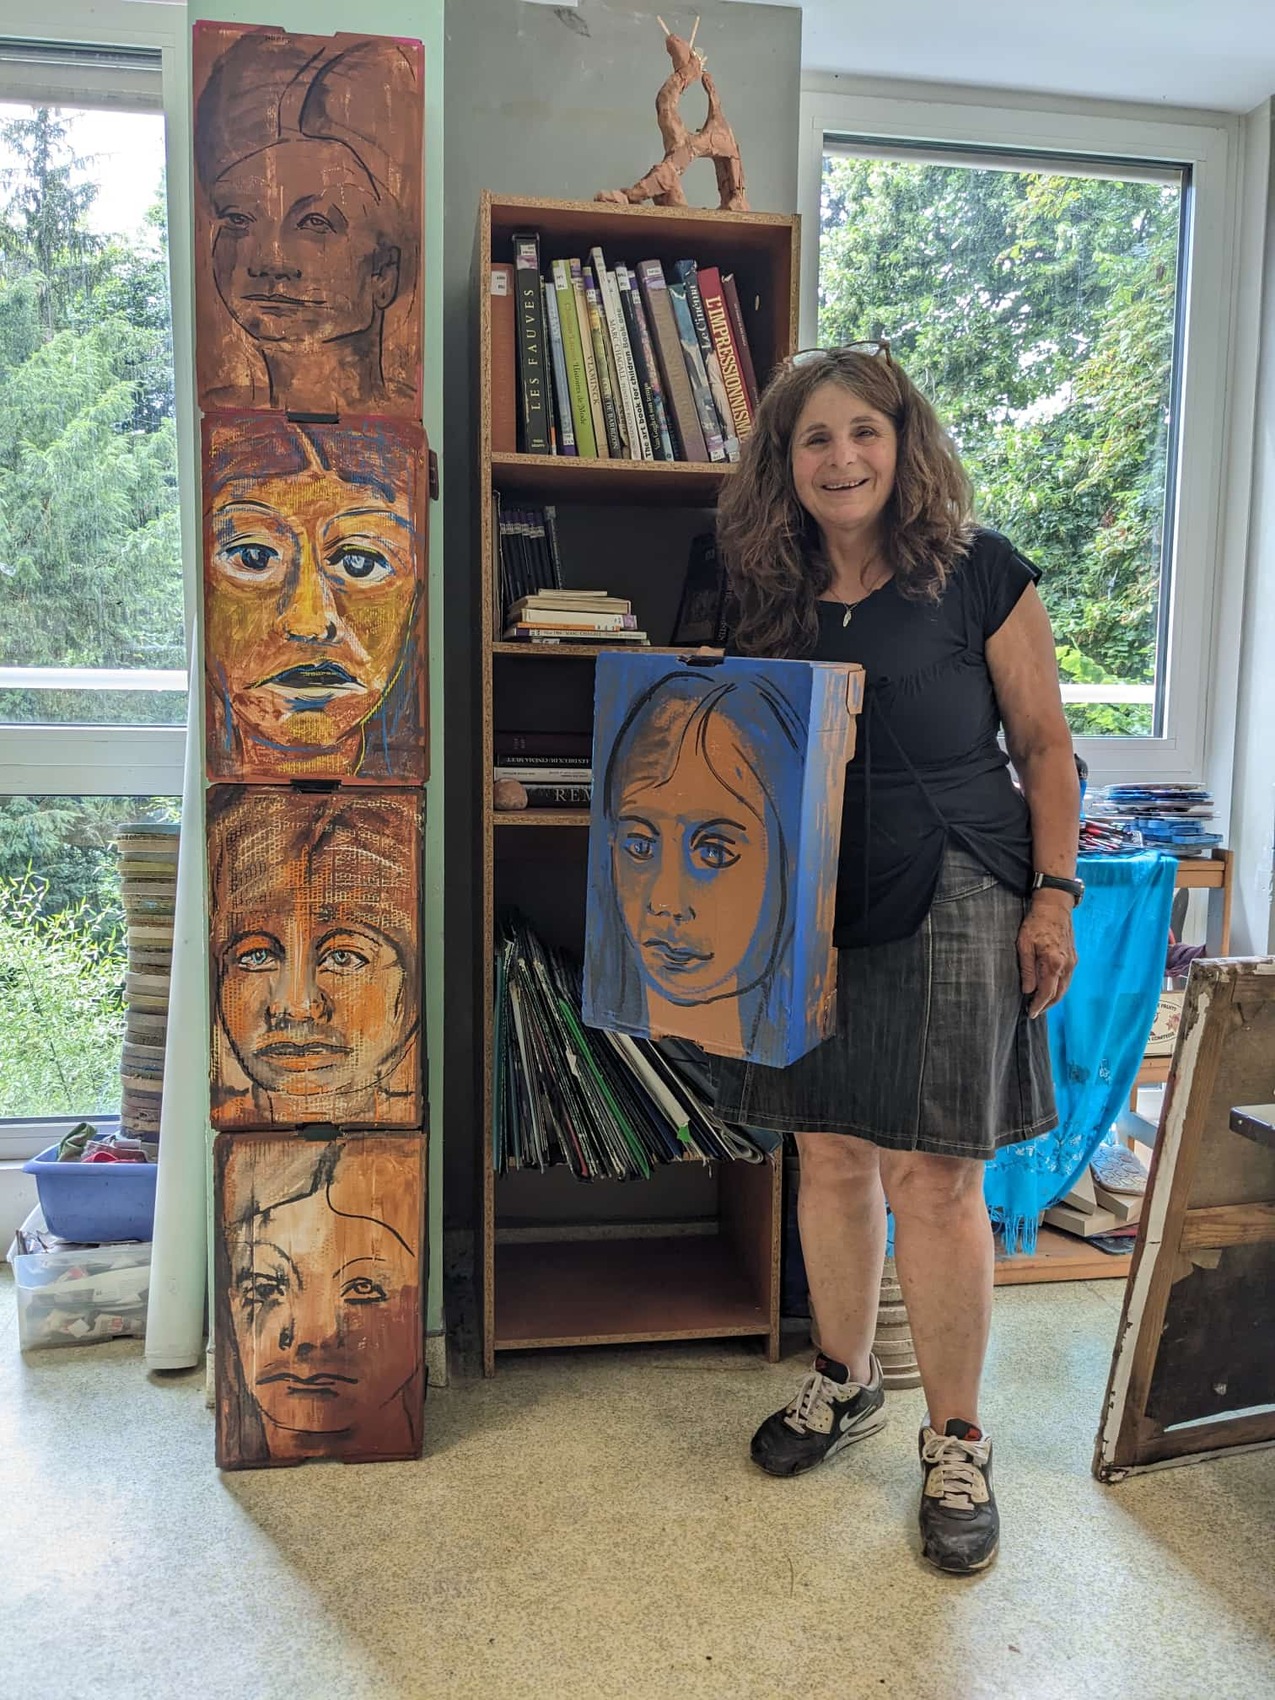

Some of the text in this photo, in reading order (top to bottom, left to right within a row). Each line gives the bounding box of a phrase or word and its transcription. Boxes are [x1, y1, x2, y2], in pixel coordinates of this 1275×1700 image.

[524, 289, 541, 411] LES FAUVES
[609, 319, 619, 342] MARC
[614, 343, 626, 381] CHAGALL
[698, 331, 711, 350] Le
[586, 355, 600, 405] VLAMINCK
[616, 308, 652, 458] The art book for children Book one
